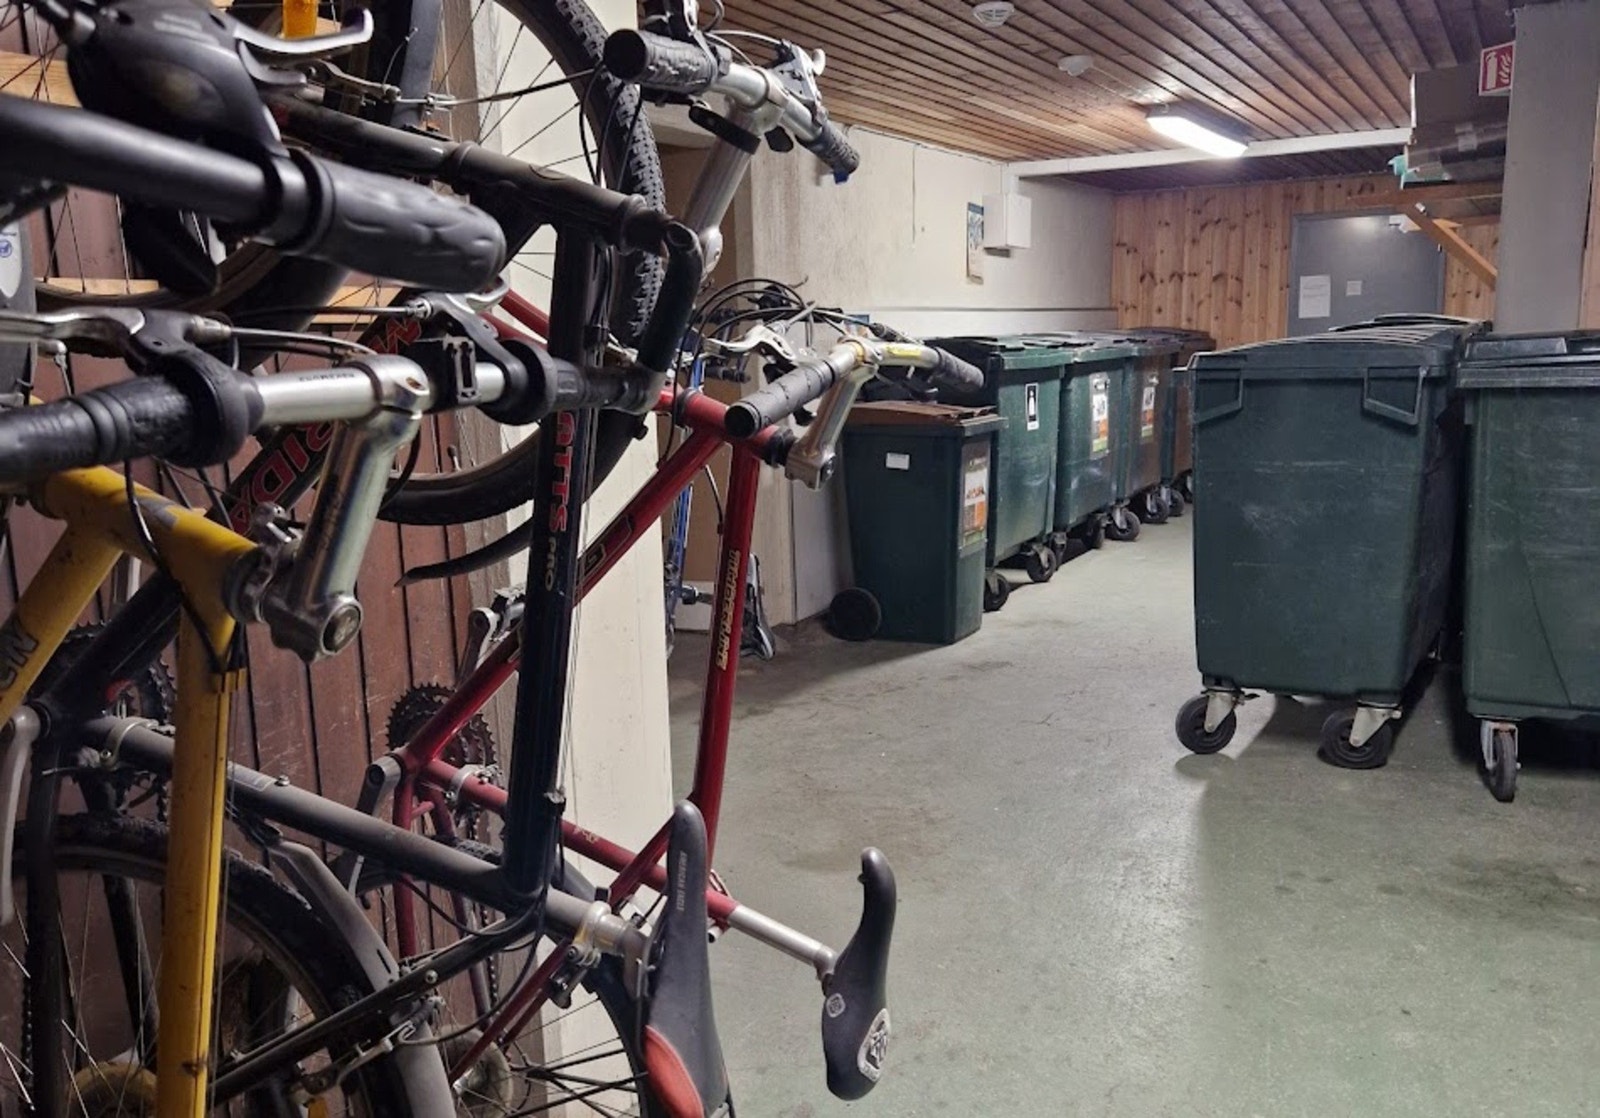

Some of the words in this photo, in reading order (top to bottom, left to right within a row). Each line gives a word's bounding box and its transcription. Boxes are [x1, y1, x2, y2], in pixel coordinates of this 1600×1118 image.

[229, 317, 421, 536] MRIDA
[550, 411, 575, 532] ATTS
[545, 536, 557, 591] PRO
[716, 549, 740, 671] TIMBERLINE
